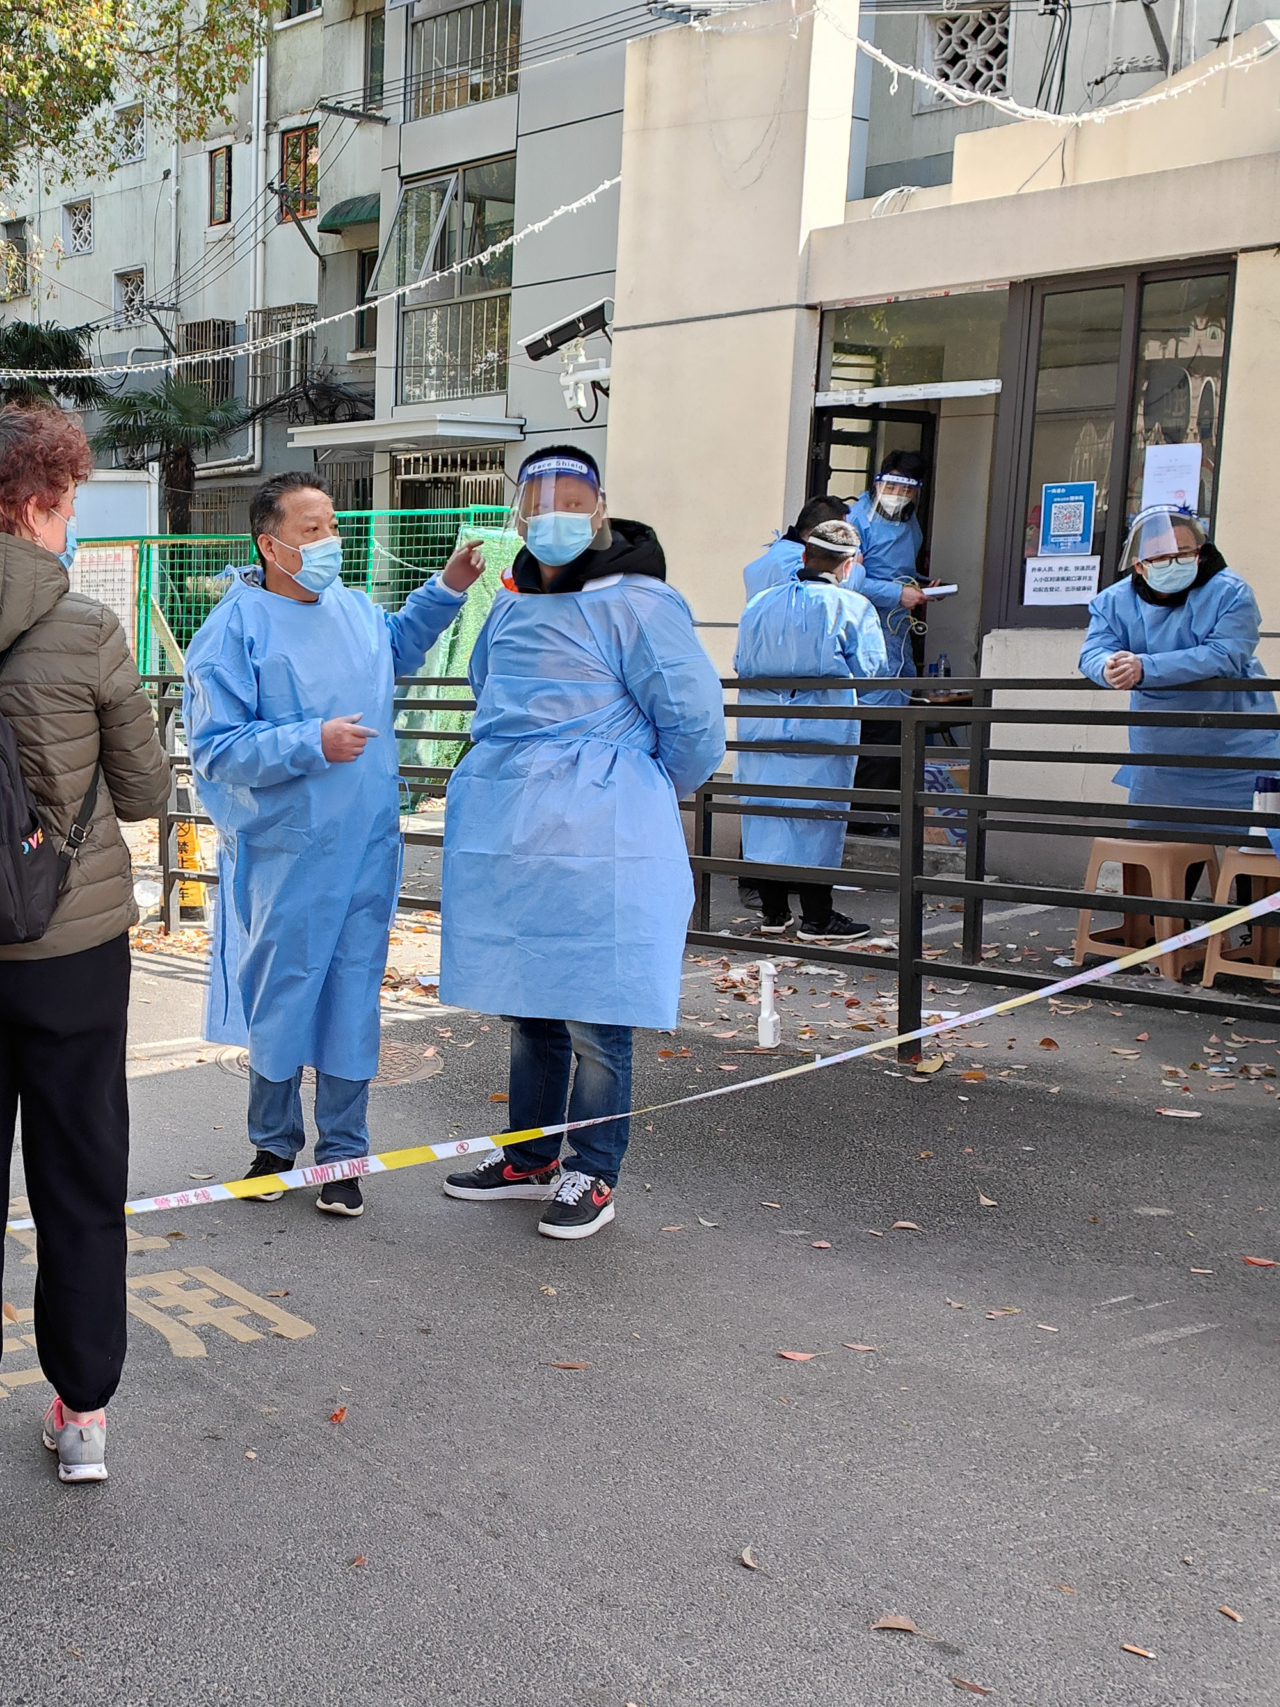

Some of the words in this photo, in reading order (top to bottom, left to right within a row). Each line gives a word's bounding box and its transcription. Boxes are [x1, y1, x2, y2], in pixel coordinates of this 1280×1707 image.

[301, 1163, 339, 1186] LIMIT
[340, 1157, 371, 1178] LINE
[153, 1189, 214, 1210] 警戒线
